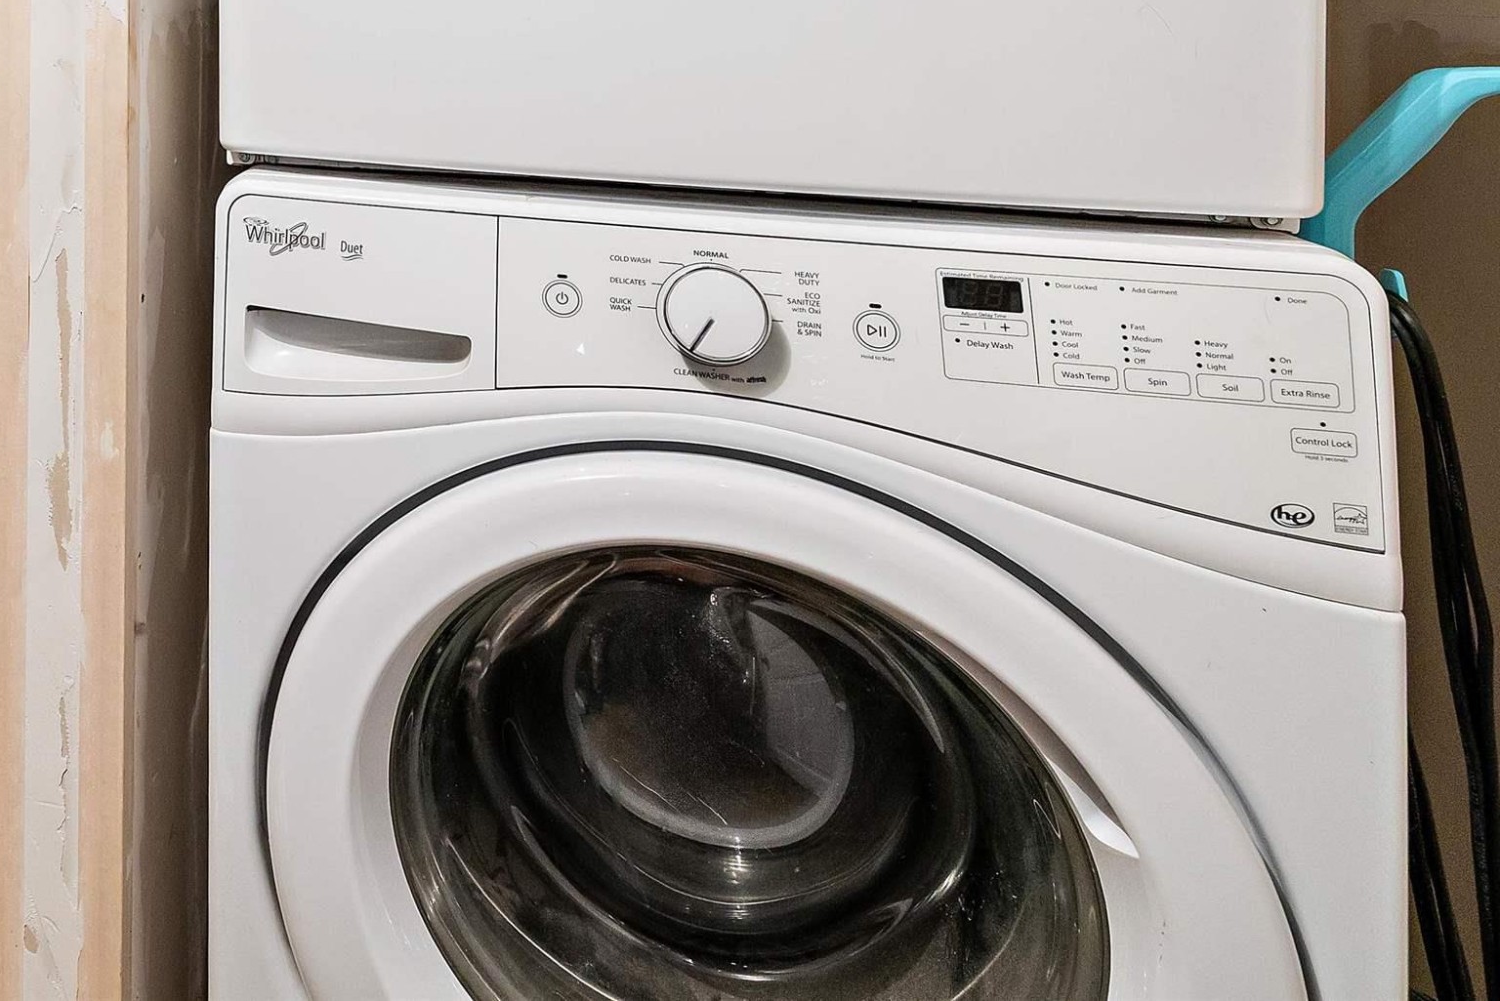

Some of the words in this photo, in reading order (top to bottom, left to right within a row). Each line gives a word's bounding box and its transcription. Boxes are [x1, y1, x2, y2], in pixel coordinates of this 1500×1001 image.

[245, 222, 326, 256] Whirlpool
[340, 240, 364, 256] Duet
[609, 254, 630, 263] COLD
[630, 255, 652, 264] WASH
[693, 250, 729, 260] NORMAL
[794, 270, 820, 279] HEAVY
[609, 276, 647, 286] DELICATES
[798, 278, 821, 287] DUTY
[1055, 281, 1073, 290] Door
[1073, 283, 1098, 292] Locked
[1131, 286, 1147, 295] Add
[1147, 287, 1178, 296] Garment
[804, 291, 821, 300] ECO
[609, 297, 632, 306] QUICK
[787, 298, 821, 308] SANITIZE
[1287, 297, 1308, 305] Done
[609, 304, 631, 312] WASH
[792, 306, 807, 314] with
[808, 307, 822, 315] Oxi
[796, 321, 822, 330] DRAIN
[1059, 318, 1073, 326] Hot
[1130, 323, 1146, 331] Fast
[804, 329, 823, 338] SPIN
[1061, 330, 1083, 338] Warm
[1131, 335, 1163, 344] Medium
[966, 339, 991, 350] Delay
[991, 340, 1014, 350] Wash
[1061, 341, 1079, 349] Cool
[1204, 339, 1229, 350] Heavy
[1132, 346, 1152, 354] Slow
[1062, 352, 1080, 360] Cold
[1205, 351, 1234, 361] Normal
[1279, 356, 1292, 365] On
[1133, 357, 1146, 365] Off
[1206, 362, 1227, 372] Light
[1280, 367, 1293, 376] Off
[673, 368, 698, 378] CLEAN
[698, 371, 730, 381] WASHER
[1061, 370, 1086, 381] Wash
[1086, 372, 1111, 383] Temp
[1147, 377, 1168, 388] Spin
[1222, 383, 1239, 393] Soil
[1280, 388, 1304, 399] Extra
[1305, 390, 1331, 400] Rinse
[1295, 436, 1329, 447] Control
[1331, 439, 1353, 449] Lock
